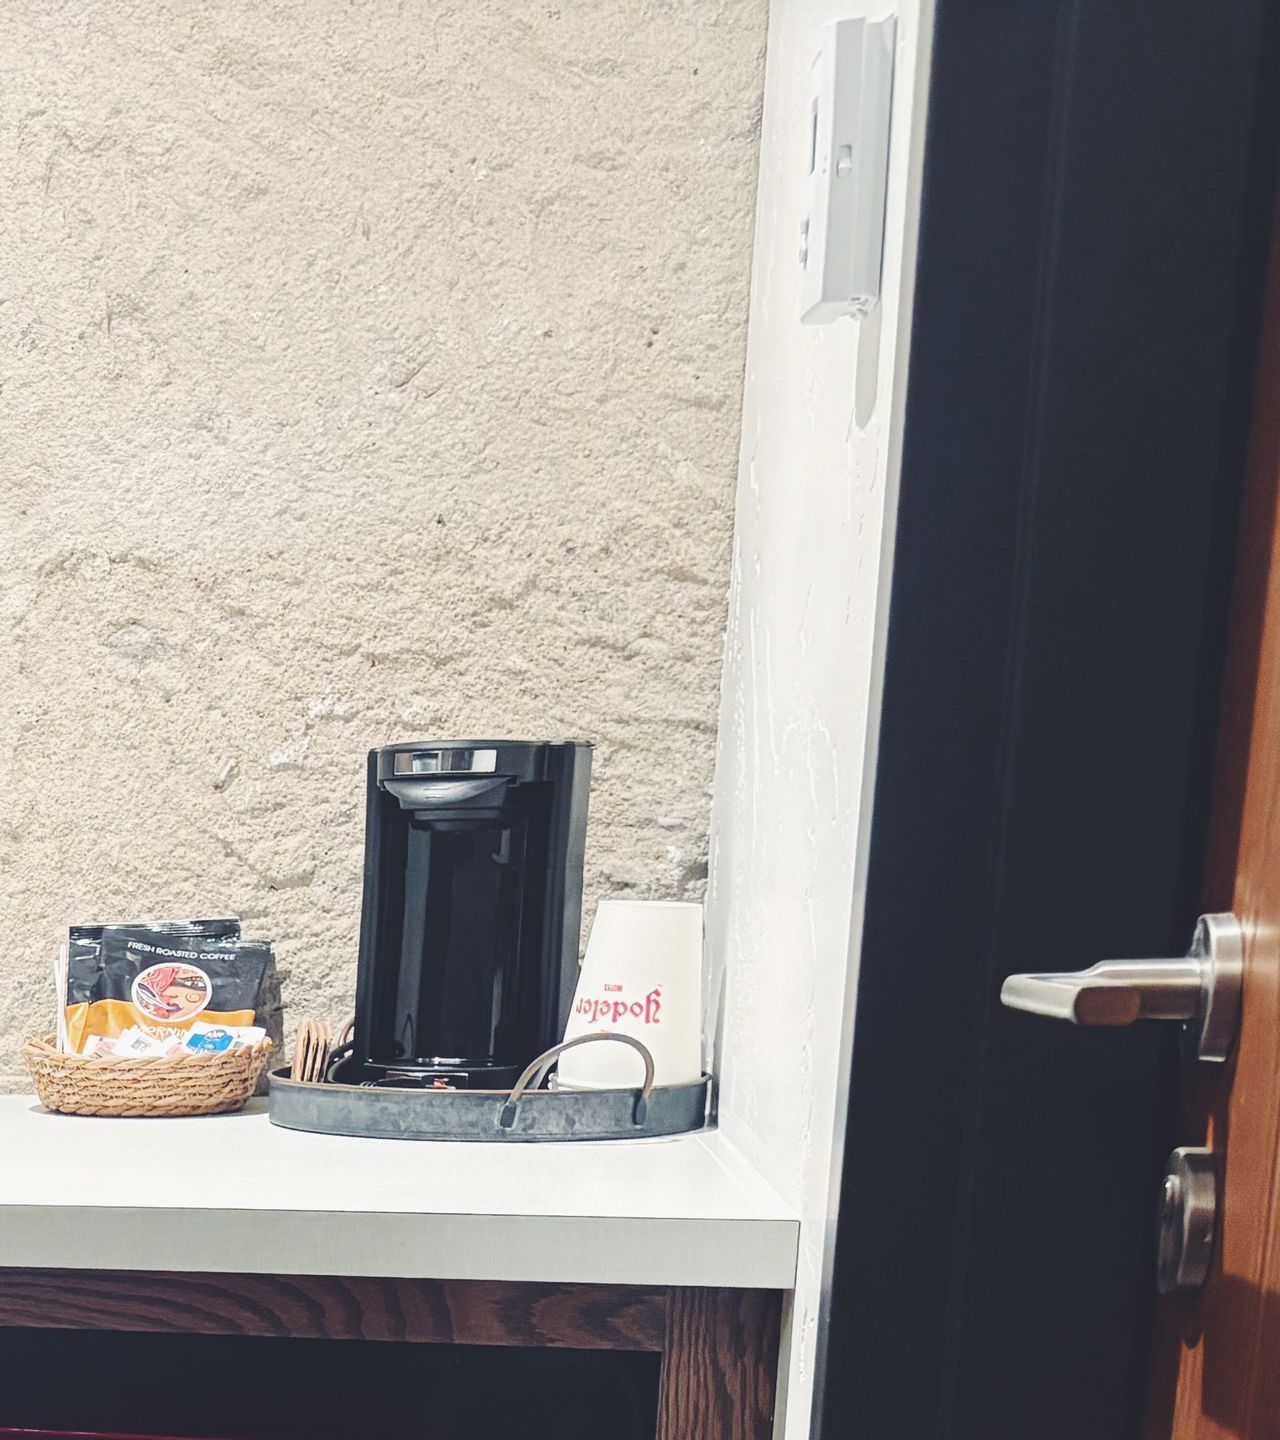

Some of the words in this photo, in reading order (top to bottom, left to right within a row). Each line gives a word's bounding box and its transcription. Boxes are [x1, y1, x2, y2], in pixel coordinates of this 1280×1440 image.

[127, 941, 155, 953] FRESH
[156, 949, 198, 959] ROASTED
[199, 953, 237, 961] COFFEE
